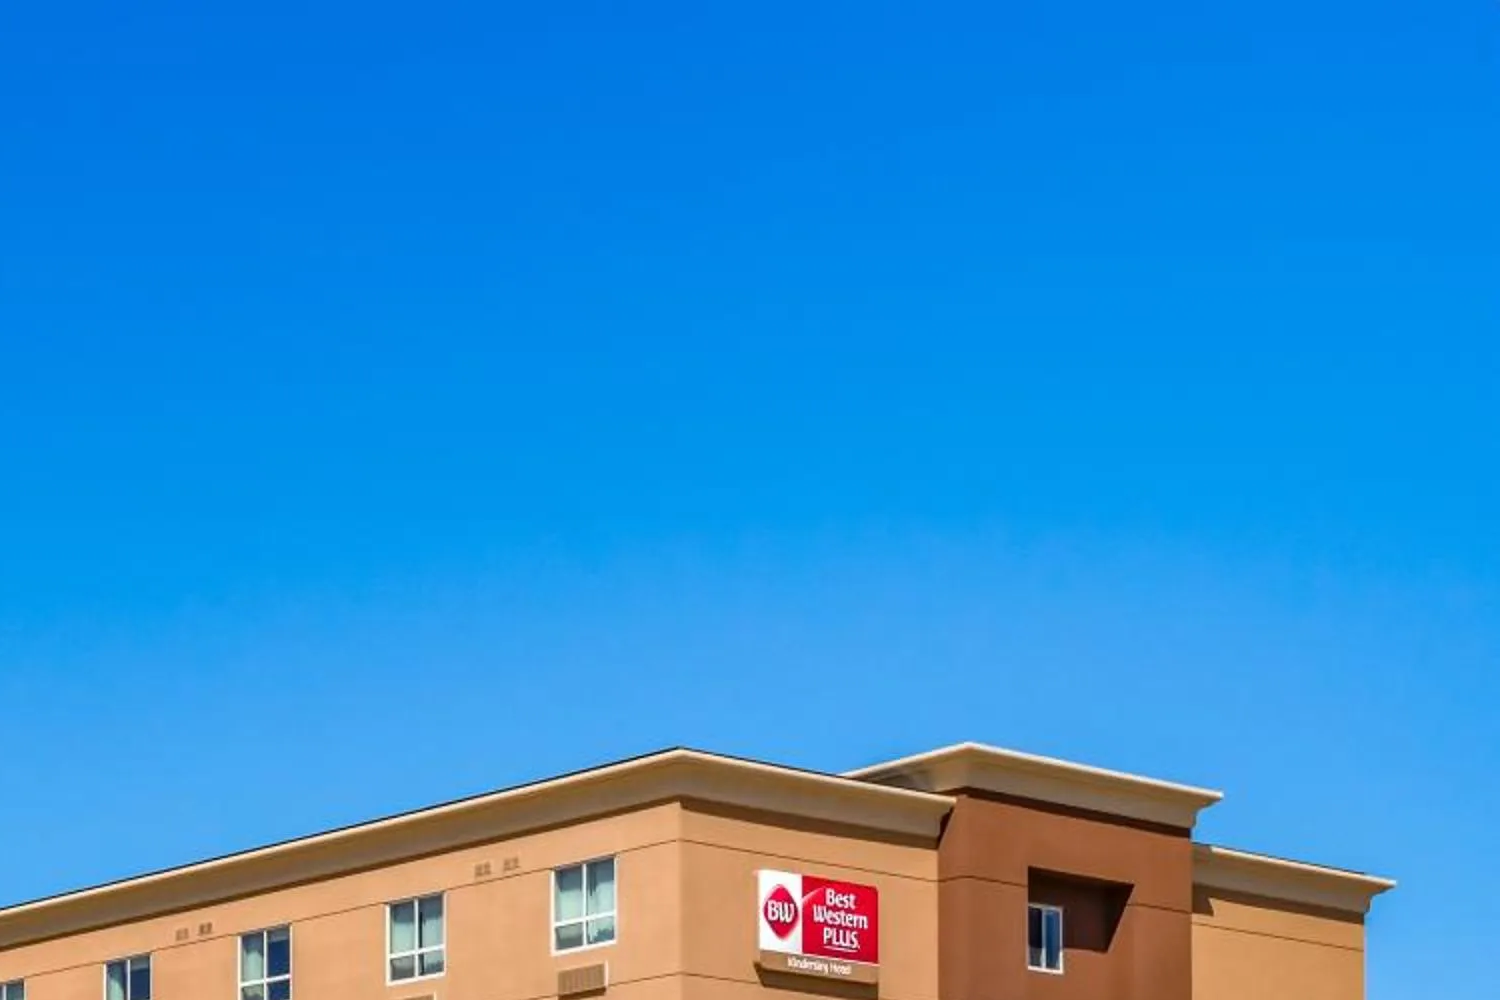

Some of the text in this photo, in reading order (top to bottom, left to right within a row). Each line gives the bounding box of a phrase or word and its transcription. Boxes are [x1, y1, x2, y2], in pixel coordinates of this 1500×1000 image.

[825, 889, 855, 909] Best
[767, 900, 795, 924] BW
[812, 905, 868, 929] Western
[823, 928, 859, 949] PLUS
